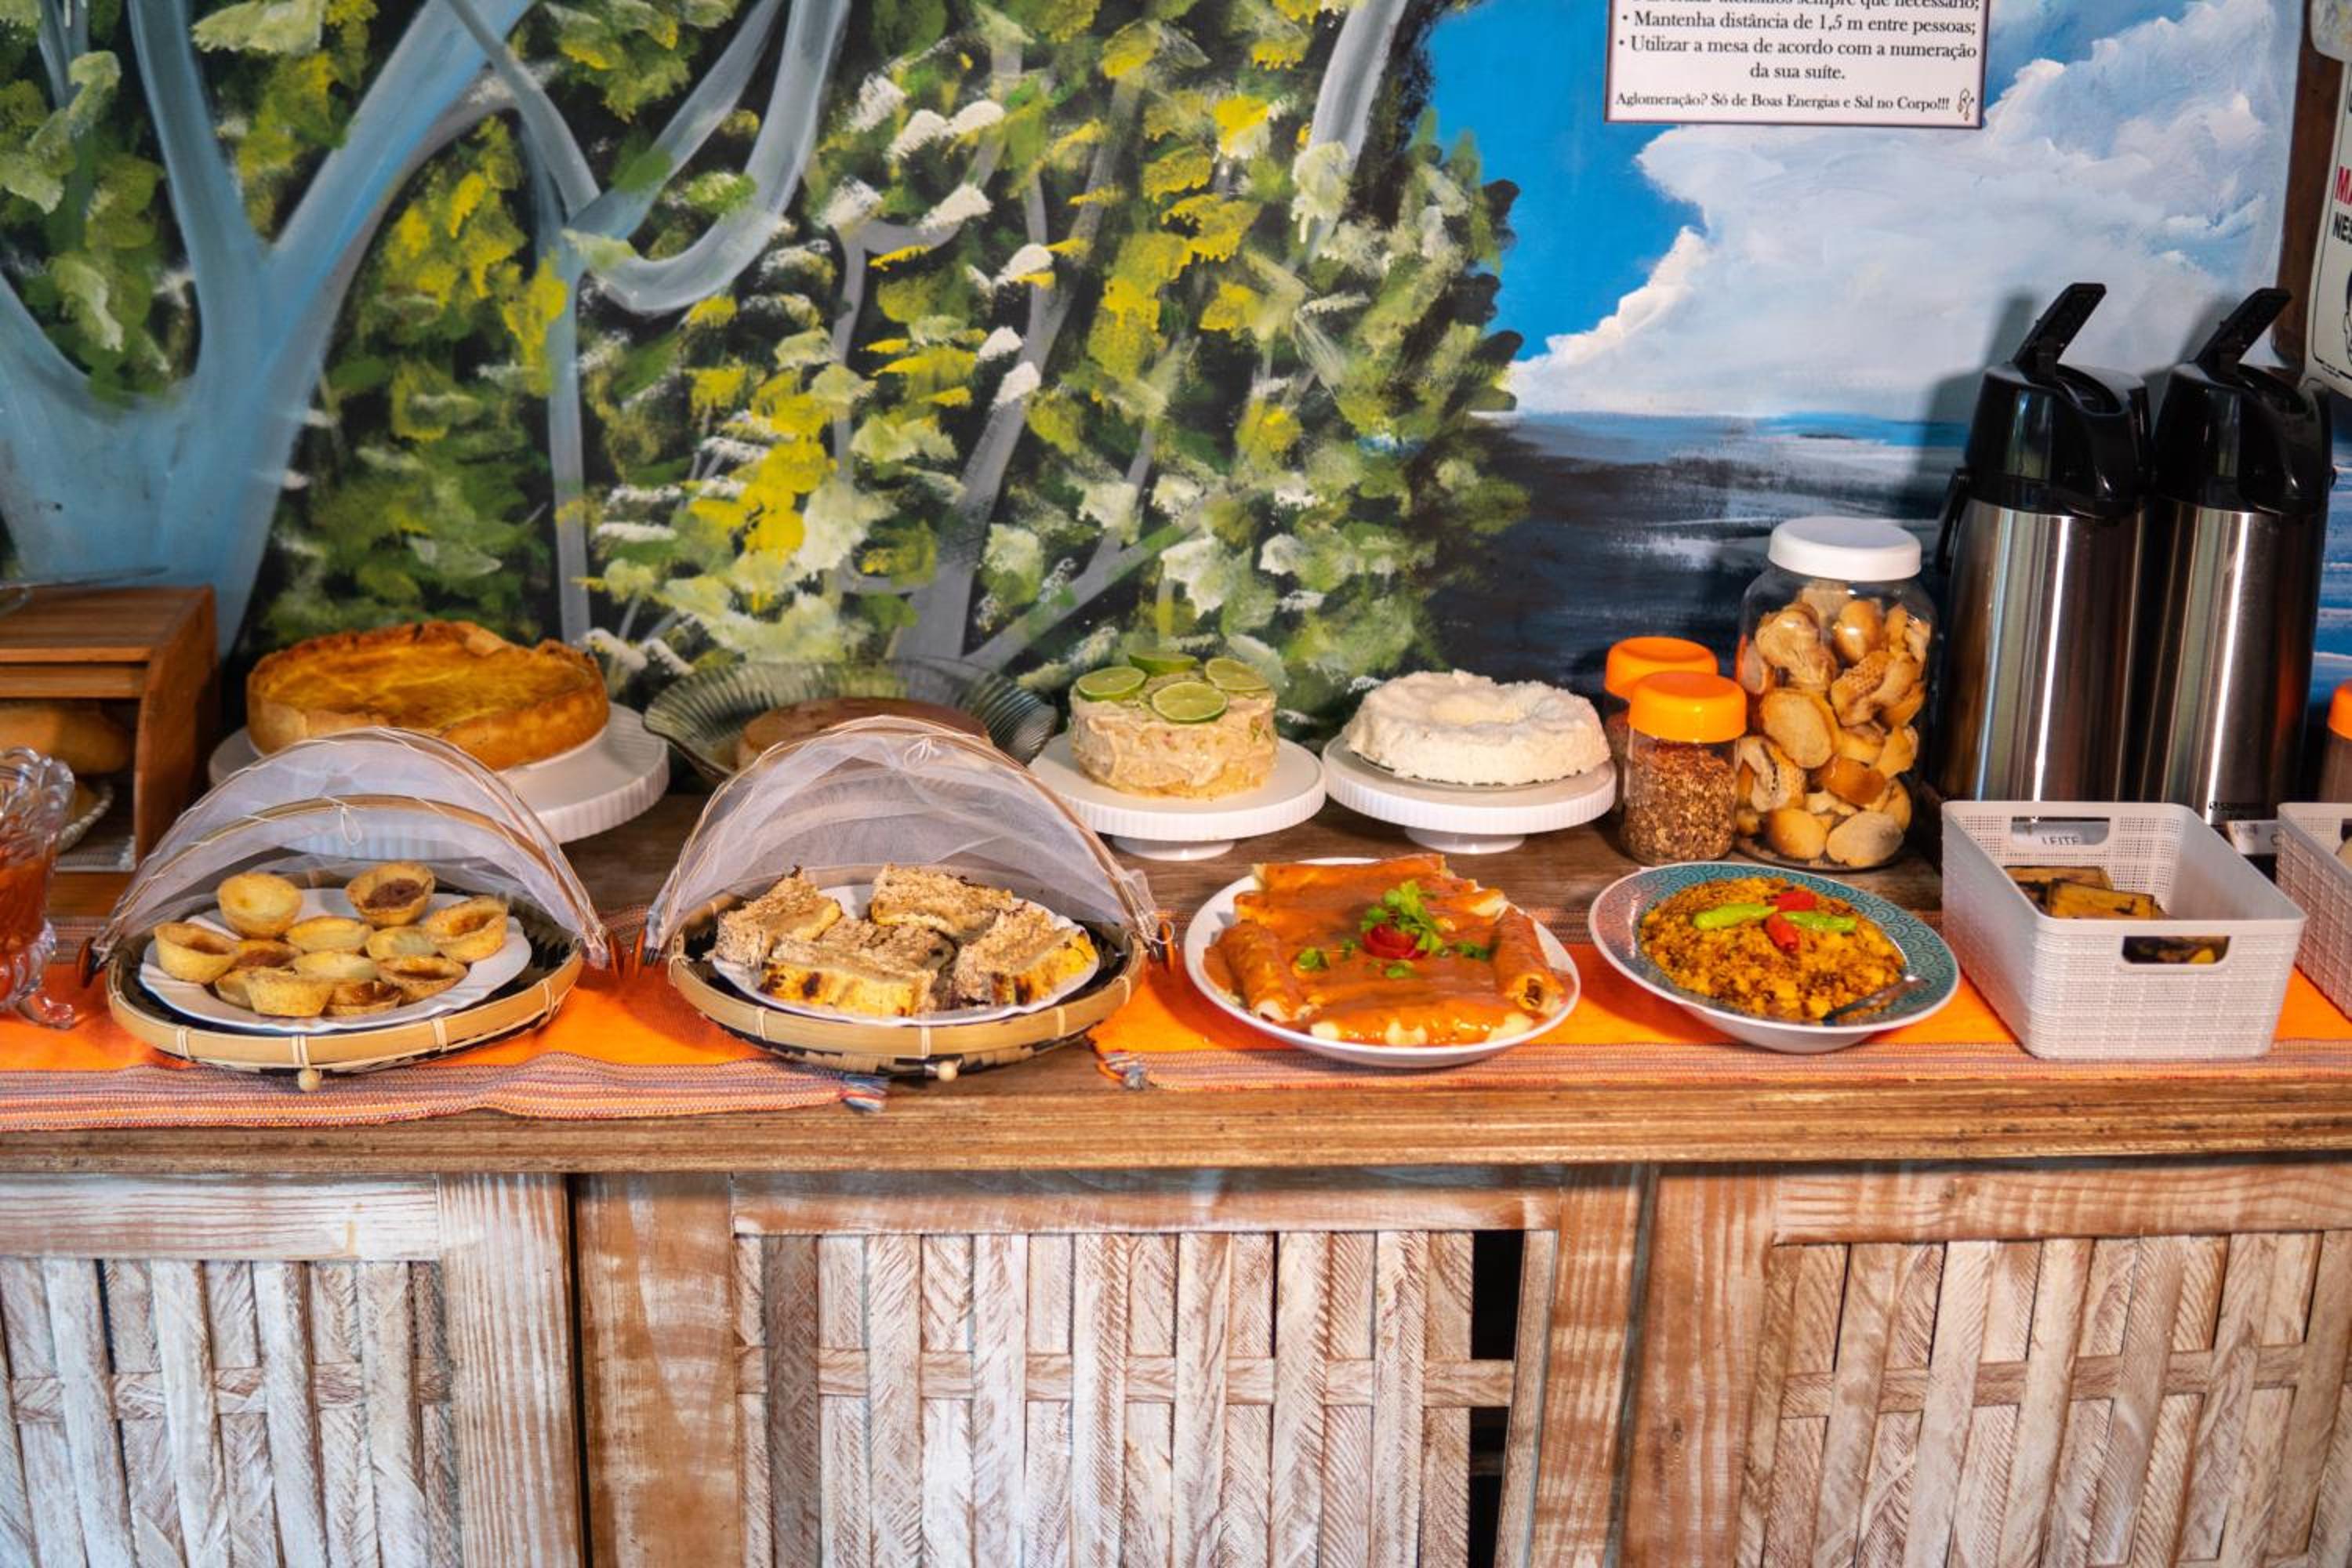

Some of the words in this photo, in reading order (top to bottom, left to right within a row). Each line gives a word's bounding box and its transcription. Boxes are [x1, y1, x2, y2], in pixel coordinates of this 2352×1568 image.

[1635, 10, 1715, 27] Mantenha
[1720, 12, 1788, 29] distância
[1793, 13, 1813, 29] de
[1820, 14, 1842, 31] 1,5
[1847, 20, 1863, 31] m
[1867, 19, 1908, 31] entre
[1912, 21, 1976, 35] pessoas;
[1631, 35, 1689, 52] Utilizar
[1693, 42, 1703, 52] a
[1708, 42, 1749, 53] mesa
[1753, 37, 1773, 53] de
[1777, 38, 1833, 54] acordo
[1837, 44, 1872, 56] com
[1877, 45, 1886, 56] a
[1890, 43, 1977, 61] numeração
[1750, 62, 1769, 78] da
[1774, 67, 1800, 78] sua
[1805, 64, 1845, 79] suíte.
[1616, 92, 1708, 107] Aglomeração?
[1711, 93, 1728, 106] Só
[1731, 93, 1747, 107] de
[1751, 93, 1783, 107] Boas
[1787, 94, 1840, 110] Energias
[1843, 100, 1850, 108] e
[1854, 96, 1873, 108] Sal
[1897, 96, 1950, 112] Corpo!!!
